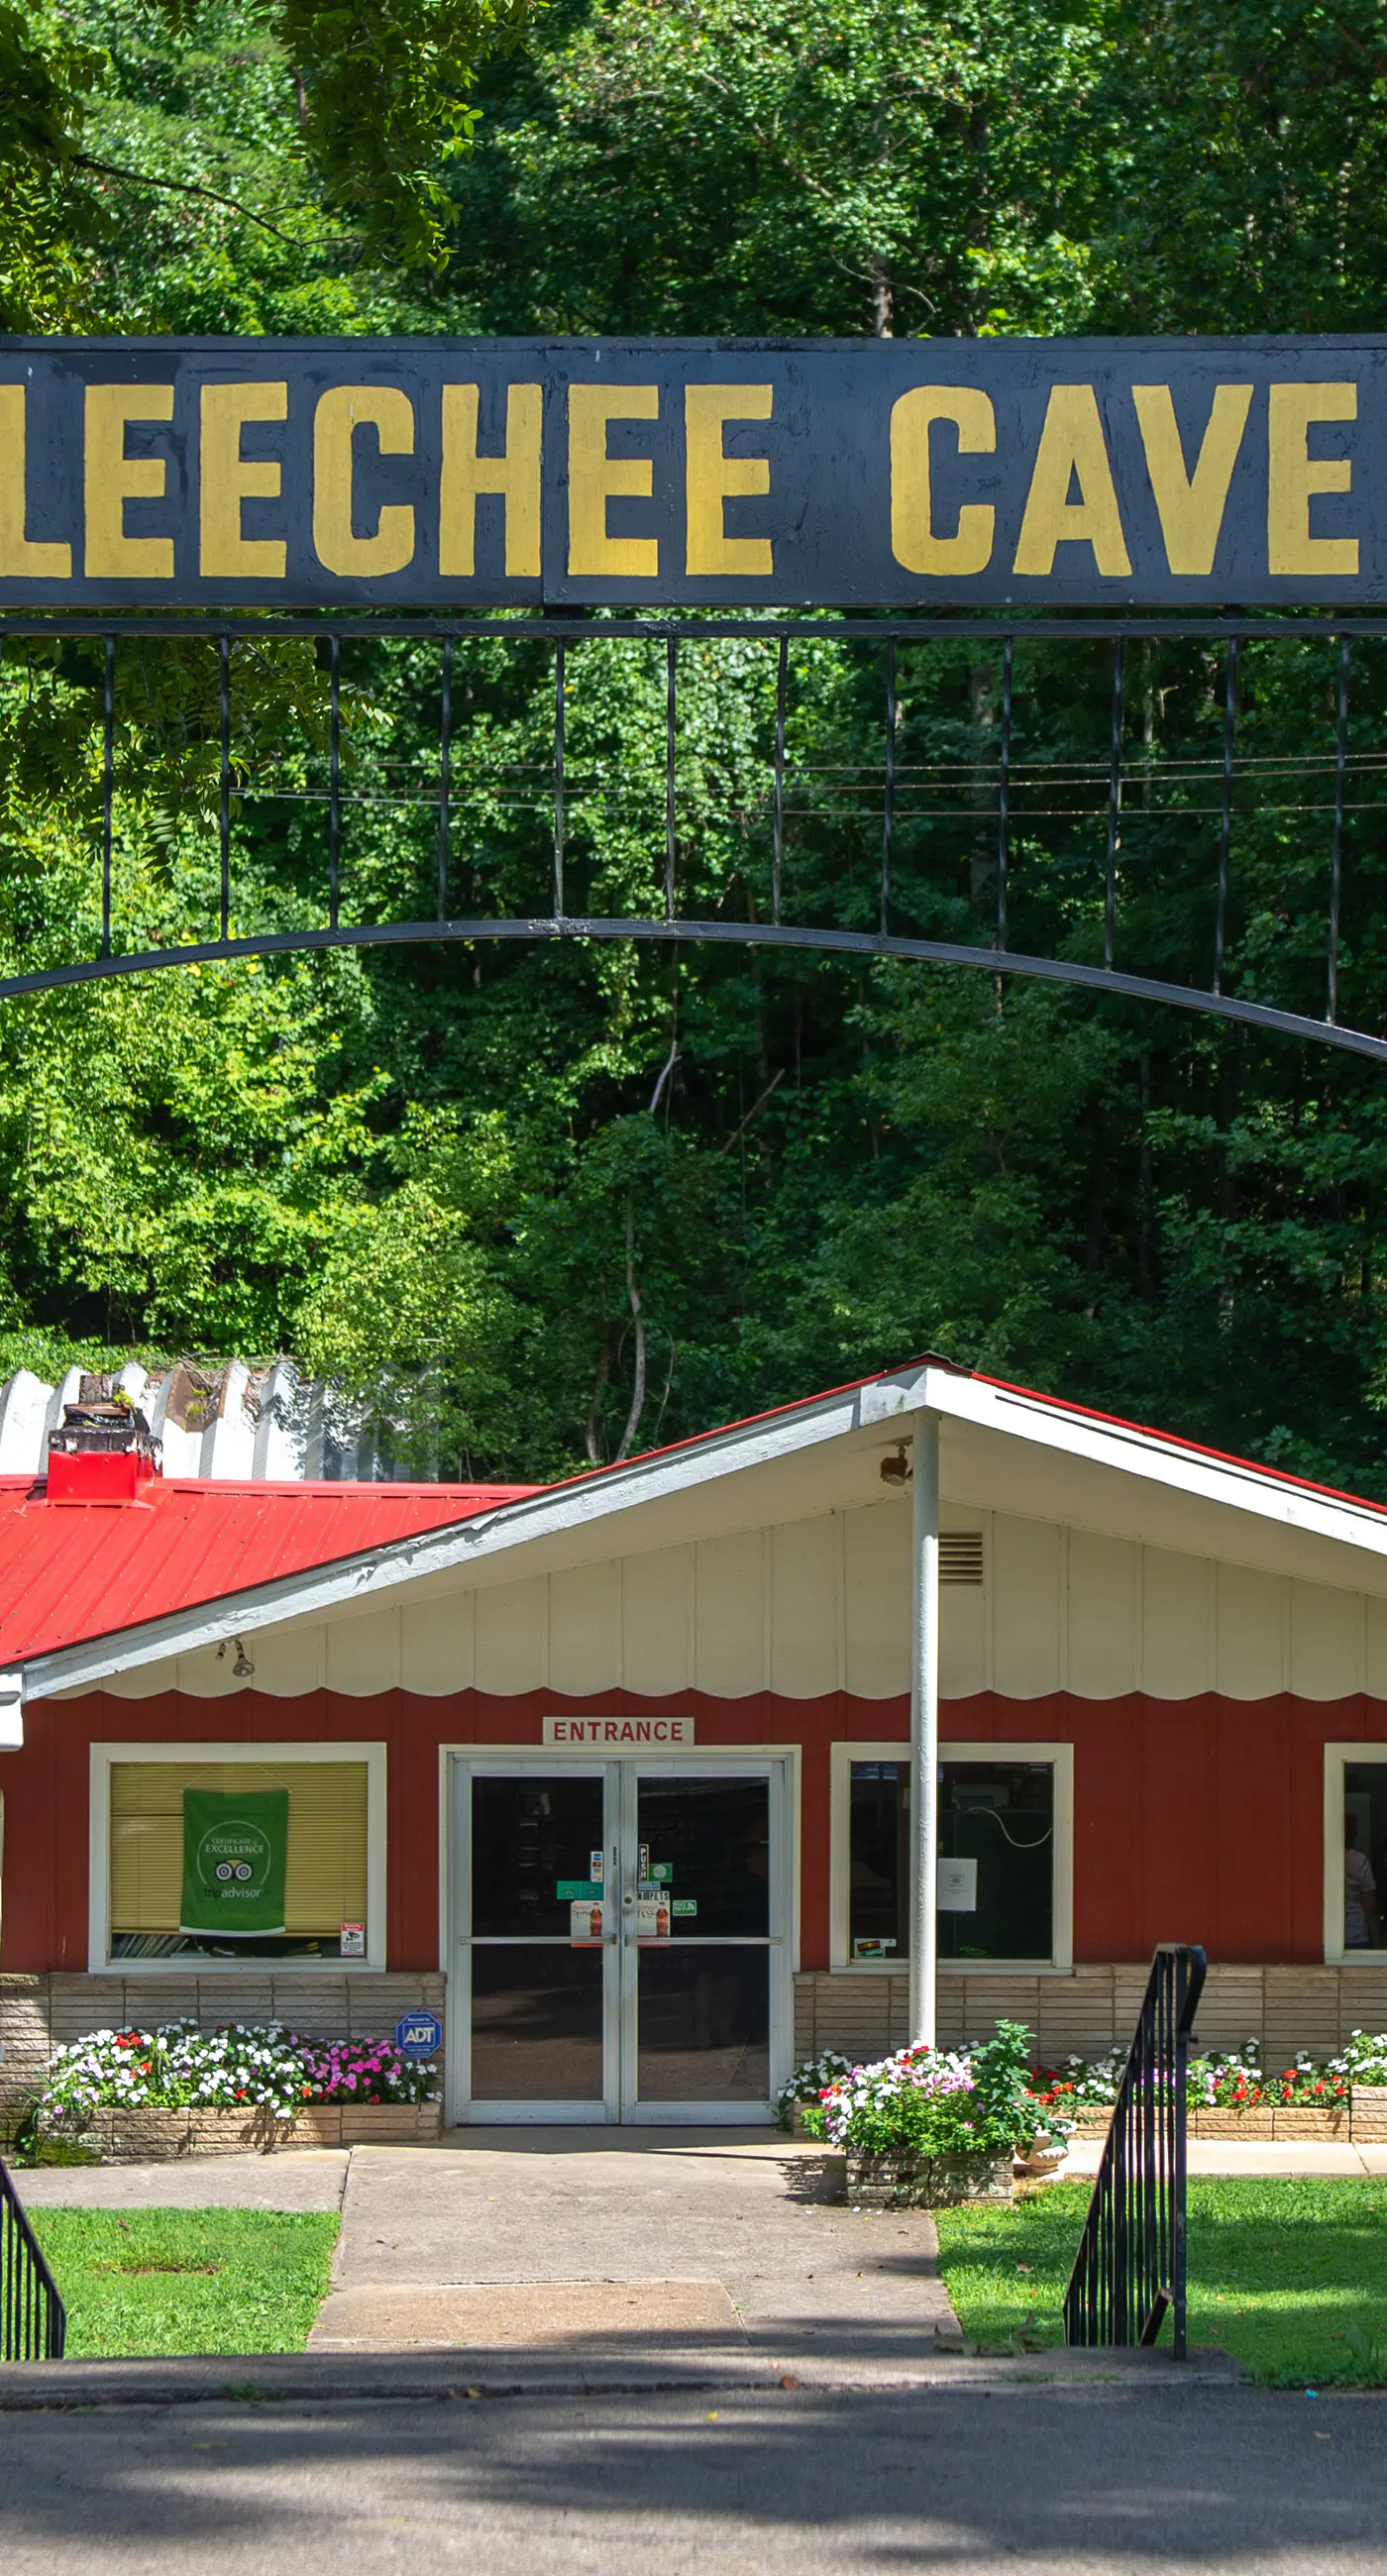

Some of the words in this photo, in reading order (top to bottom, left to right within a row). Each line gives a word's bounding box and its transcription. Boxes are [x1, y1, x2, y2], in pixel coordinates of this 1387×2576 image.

[0, 380, 774, 578] LEECHEE
[890, 381, 1359, 577] CAVE
[554, 1721, 684, 1742] ENTRANCE
[205, 1844, 265, 1854] EXCELLENCE
[204, 1886, 262, 1900] tripadvisor
[649, 1891, 669, 1900] PETS
[403, 2027, 435, 2043] ADT
